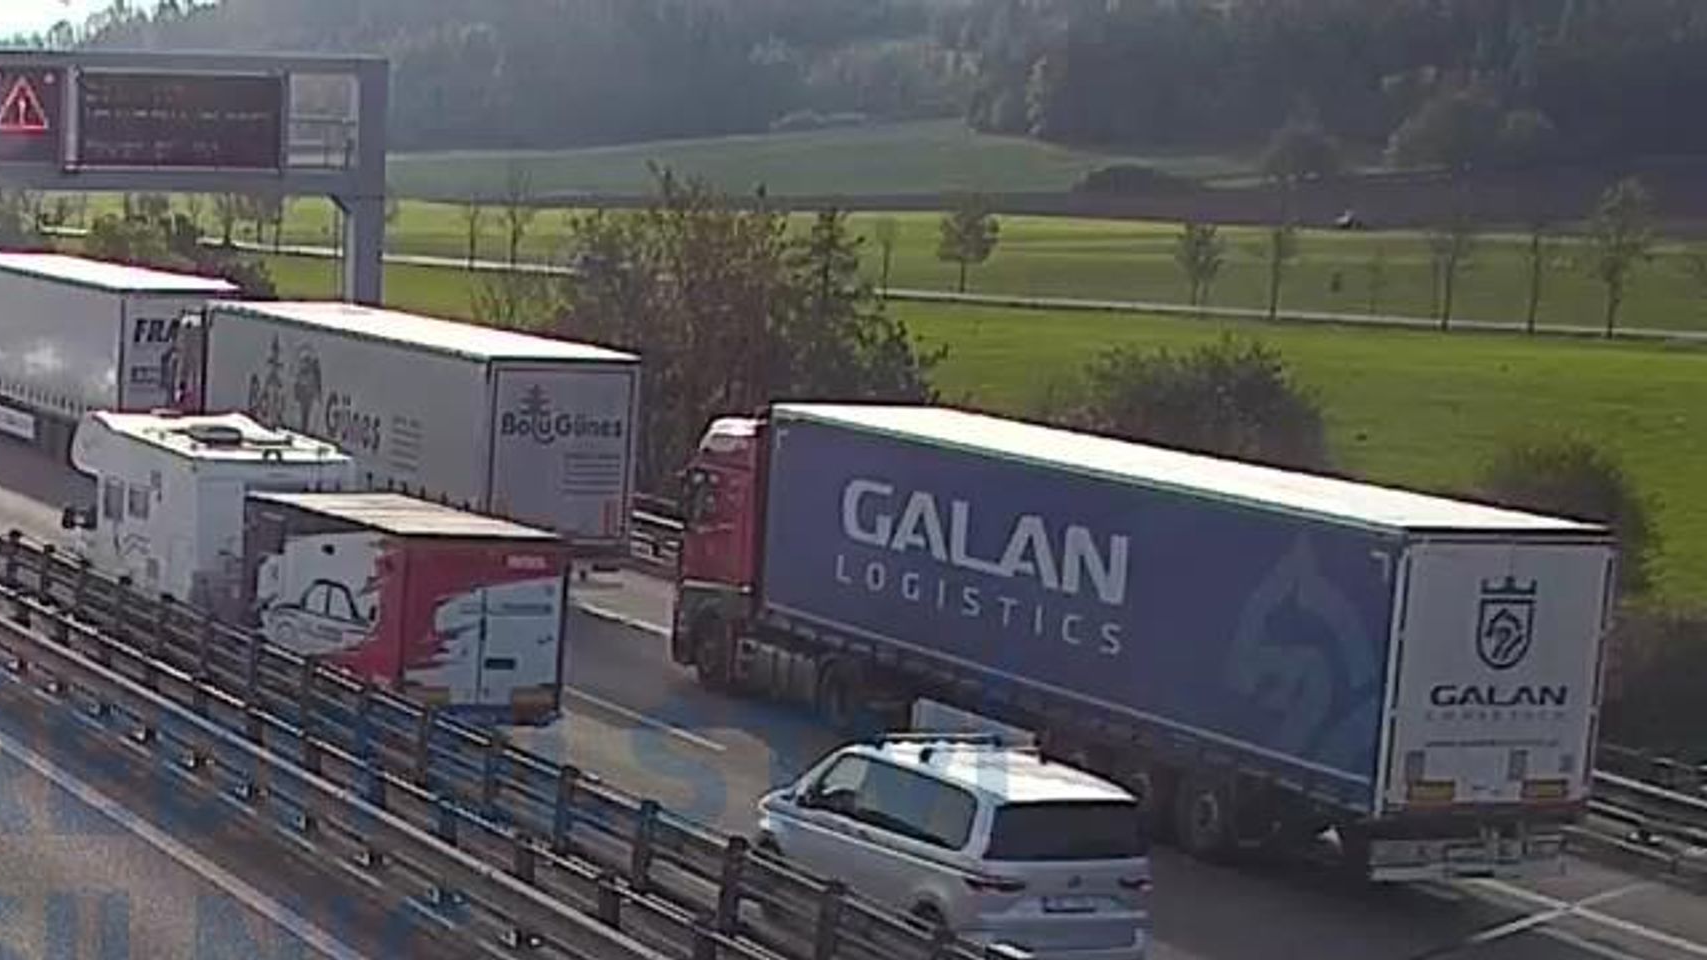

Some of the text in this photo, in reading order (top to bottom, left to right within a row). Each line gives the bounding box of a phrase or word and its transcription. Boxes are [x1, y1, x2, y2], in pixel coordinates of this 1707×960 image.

[842, 479, 1129, 605] GALAN
[836, 554, 1122, 655] LOGISTICS
[1430, 685, 1568, 706] GALAN
